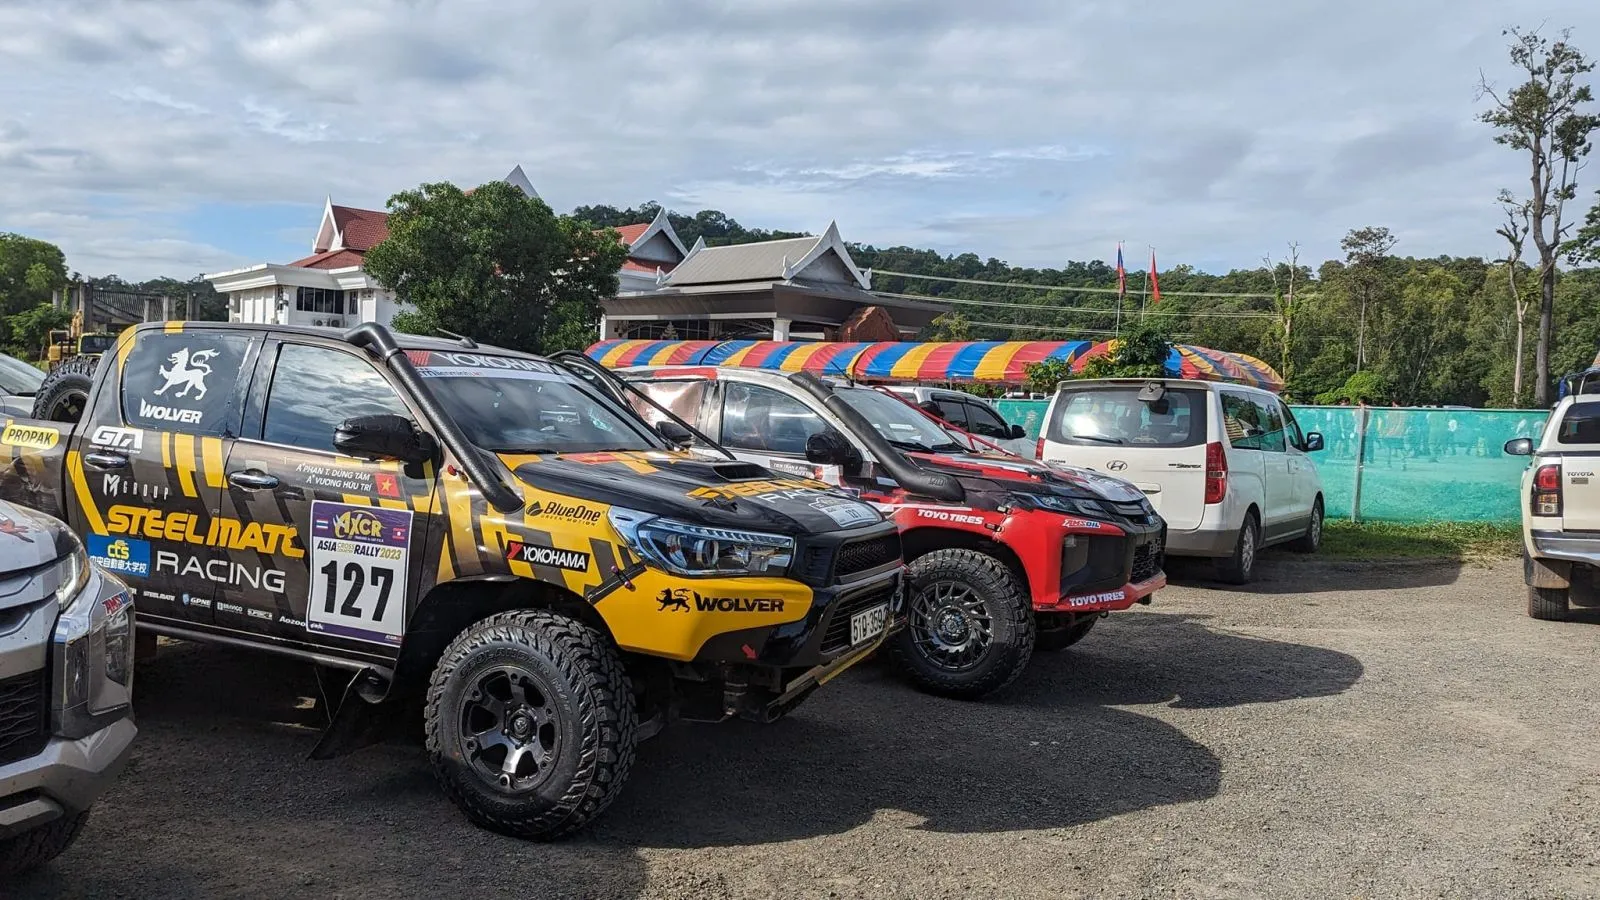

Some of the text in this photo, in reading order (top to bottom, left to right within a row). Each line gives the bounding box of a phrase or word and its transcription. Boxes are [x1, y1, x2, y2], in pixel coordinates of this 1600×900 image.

[434, 352, 562, 375] YOKOHAM
[139, 397, 203, 424] WOLVER
[7, 428, 53, 445] PROPAK
[123, 481, 169, 500] GROUP
[544, 501, 601, 522] BlueOne
[918, 510, 984, 525] TOYO TIRES
[333, 511, 383, 539] AXCR
[317, 540, 337, 552] ASIA
[354, 545, 381, 558] RALLY
[379, 548, 402, 560] 2023
[523, 546, 586, 569] YOKOHAMA
[156, 550, 286, 593] RACING
[321, 560, 394, 622] 127
[692, 591, 784, 612] WOLVER
[1069, 591, 1125, 607] TOYO TIRES
